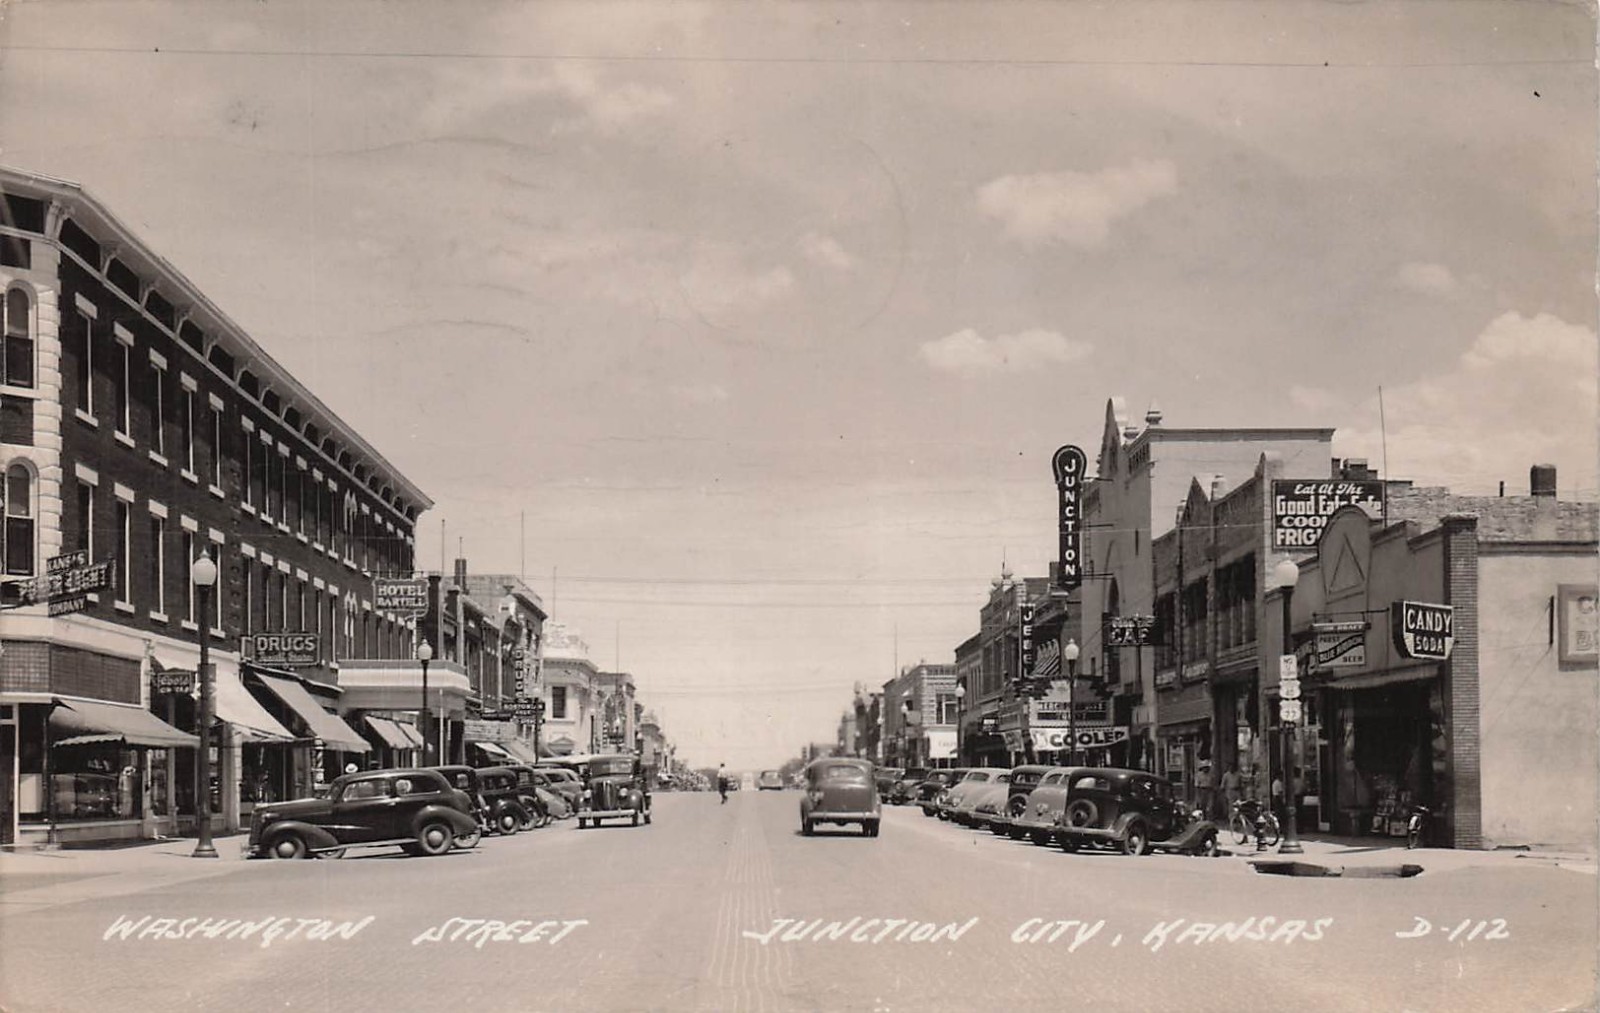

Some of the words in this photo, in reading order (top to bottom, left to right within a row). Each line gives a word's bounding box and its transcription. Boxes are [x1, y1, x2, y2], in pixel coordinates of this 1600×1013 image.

[1294, 483, 1316, 495] Eat
[1335, 483, 1364, 495] The
[1276, 495, 1315, 516] Good
[1064, 458, 1076, 576] JUNCTION
[378, 584, 426, 596] HOTEL
[1407, 608, 1451, 633] CANDY
[256, 636, 316, 652] DRUGS
[1416, 636, 1444, 652] SODA
